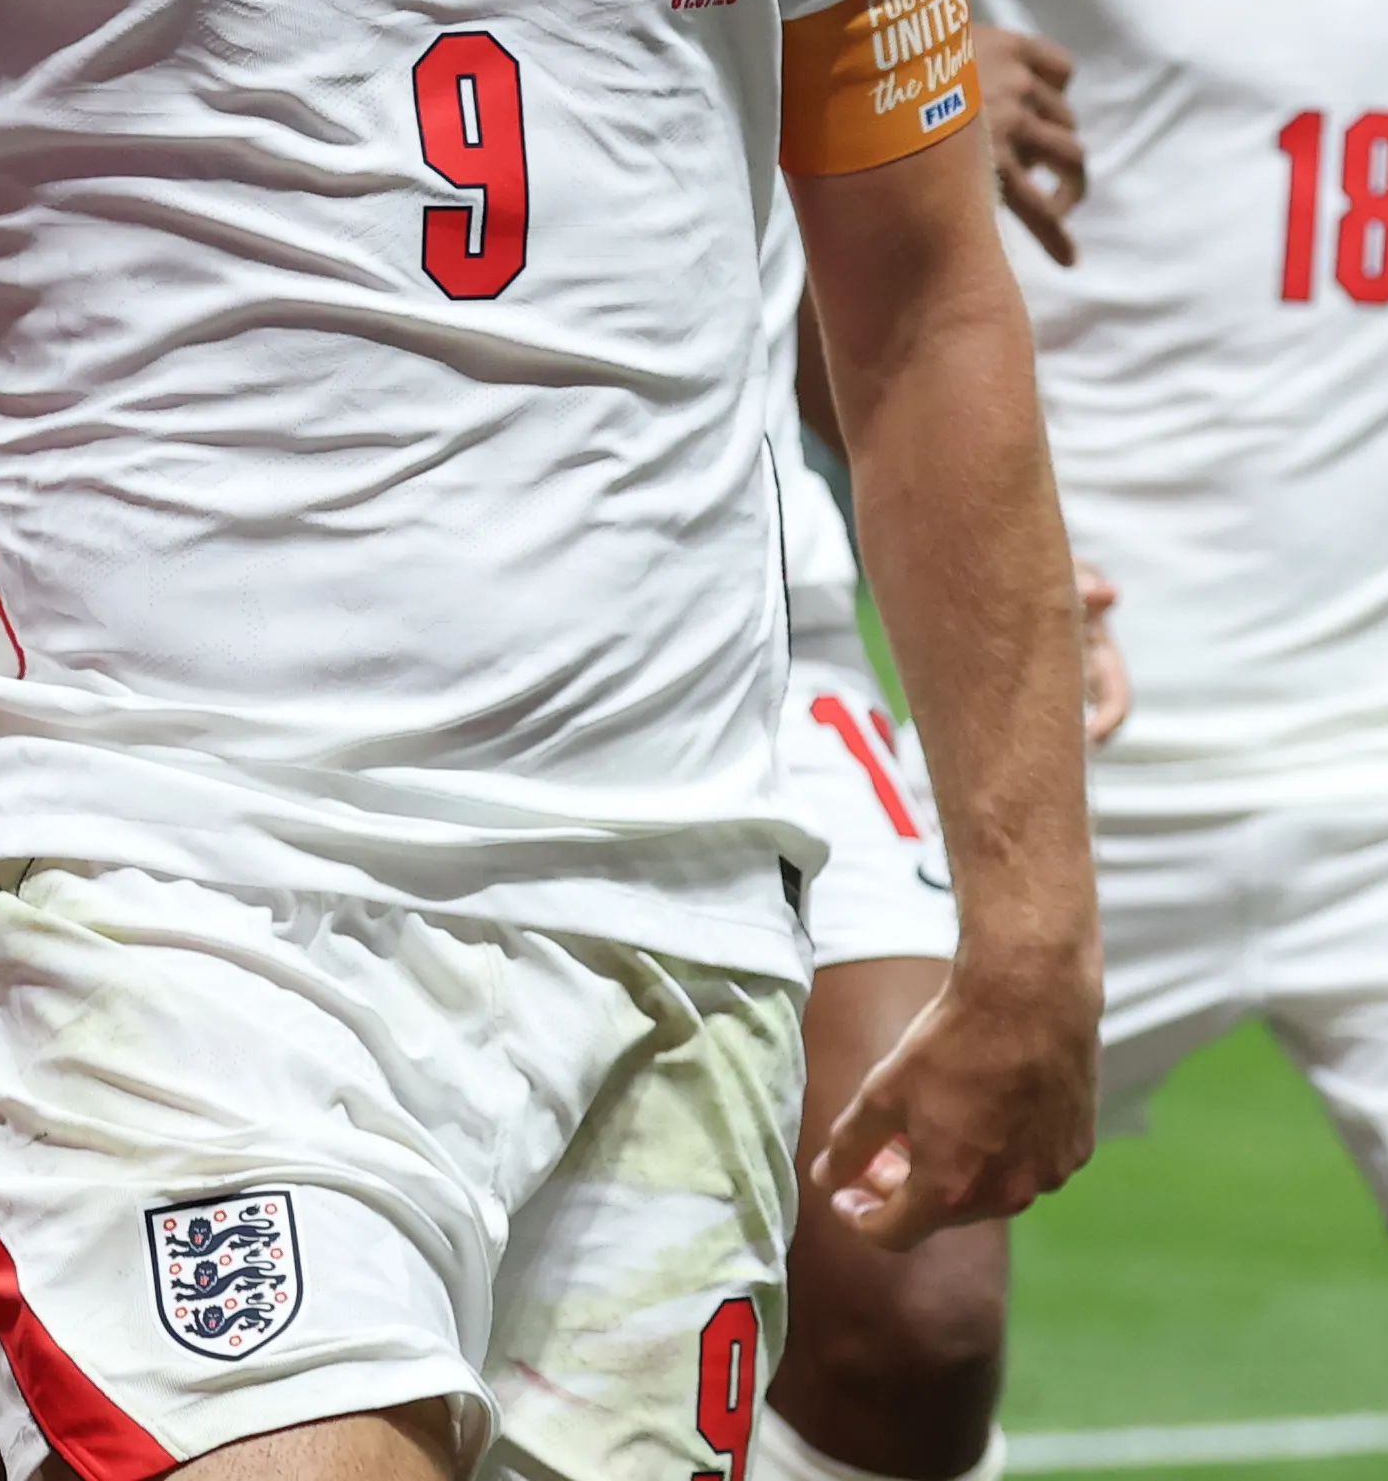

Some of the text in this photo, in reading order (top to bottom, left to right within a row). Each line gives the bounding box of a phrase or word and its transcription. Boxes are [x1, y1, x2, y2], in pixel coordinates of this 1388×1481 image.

[868, 71, 924, 115] the
[925, 92, 963, 126] FIFA
[412, 31, 529, 301] 9
[691, 1296, 759, 1481] 9
